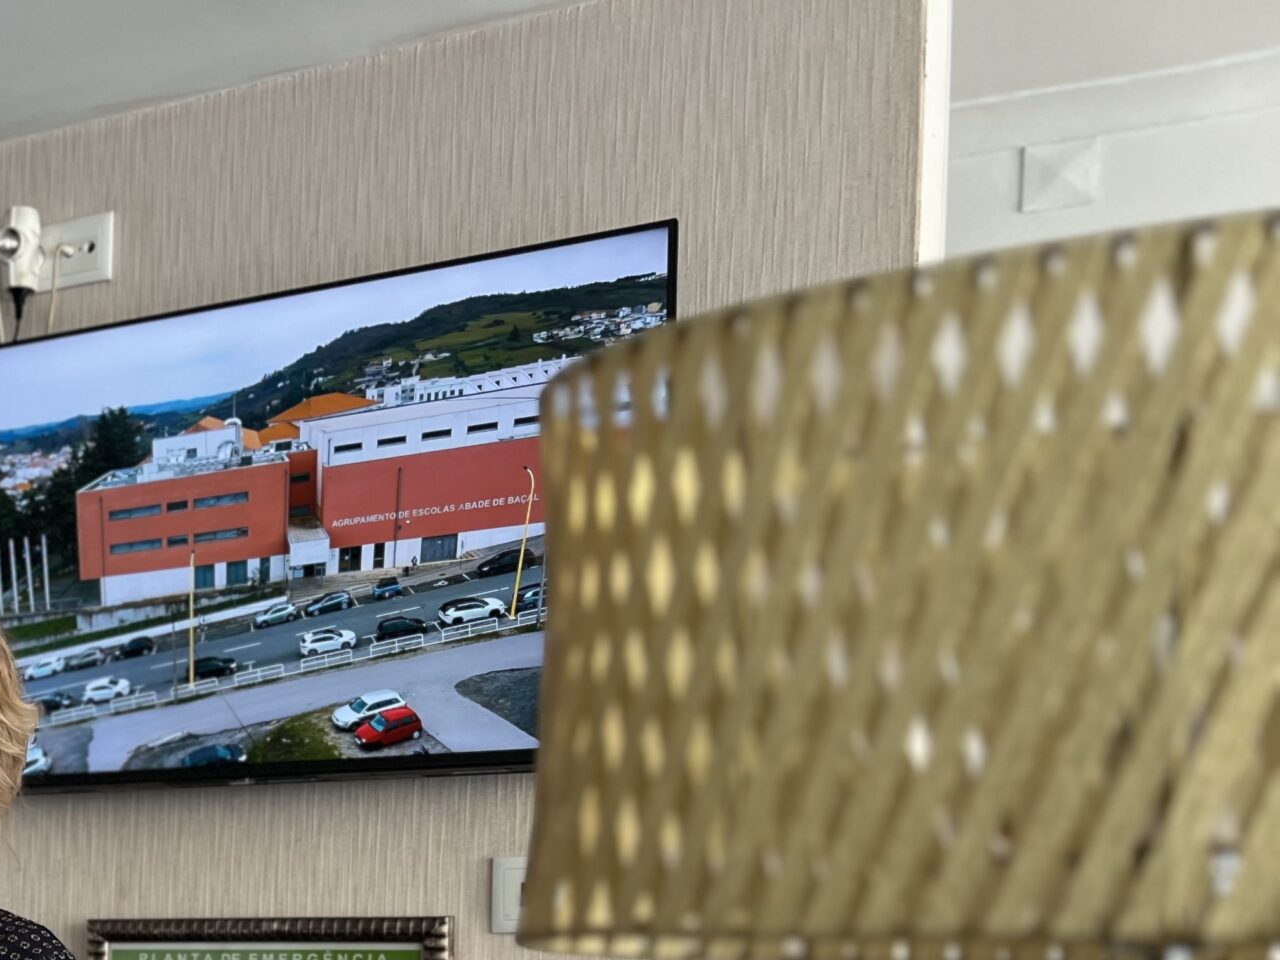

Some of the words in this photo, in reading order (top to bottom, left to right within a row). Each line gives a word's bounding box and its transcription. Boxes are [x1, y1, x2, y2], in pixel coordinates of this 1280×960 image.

[332, 513, 396, 528] AGRUPAMENTO
[398, 510, 410, 519] DE
[412, 504, 455, 517] ESCOLAS
[458, 499, 490, 511] ABADE
[493, 497, 505, 507] DE
[508, 493, 539, 506] BAÇAL
